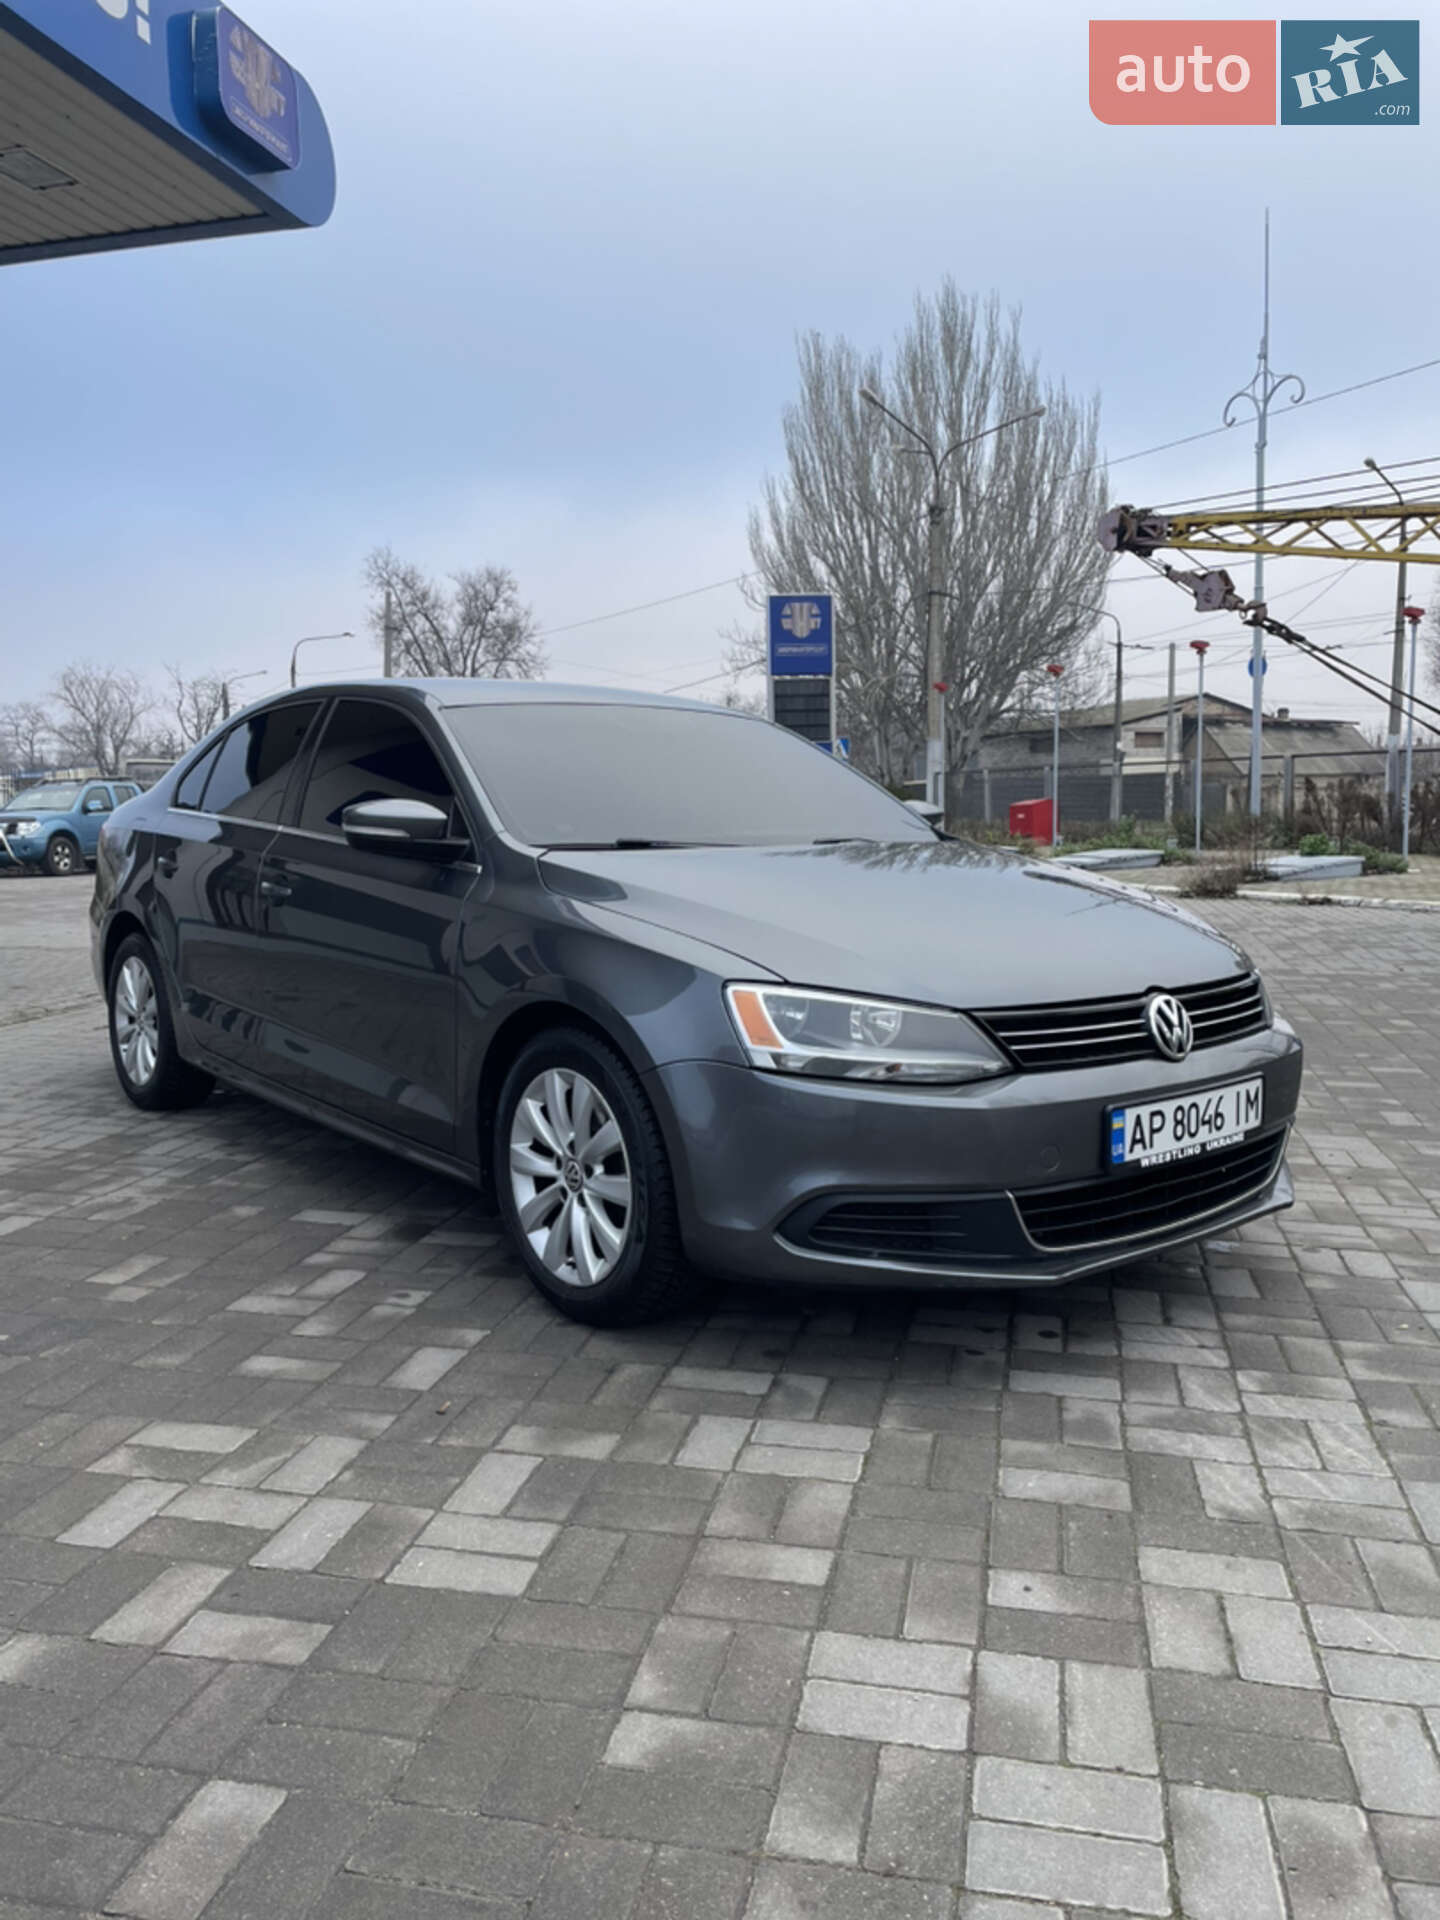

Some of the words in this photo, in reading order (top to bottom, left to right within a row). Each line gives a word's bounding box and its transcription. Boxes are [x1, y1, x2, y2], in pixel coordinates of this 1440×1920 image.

[1128, 1109, 1166, 1154] AP
[1172, 1095, 1226, 1142] 8046
[1235, 1086, 1260, 1126] IM
